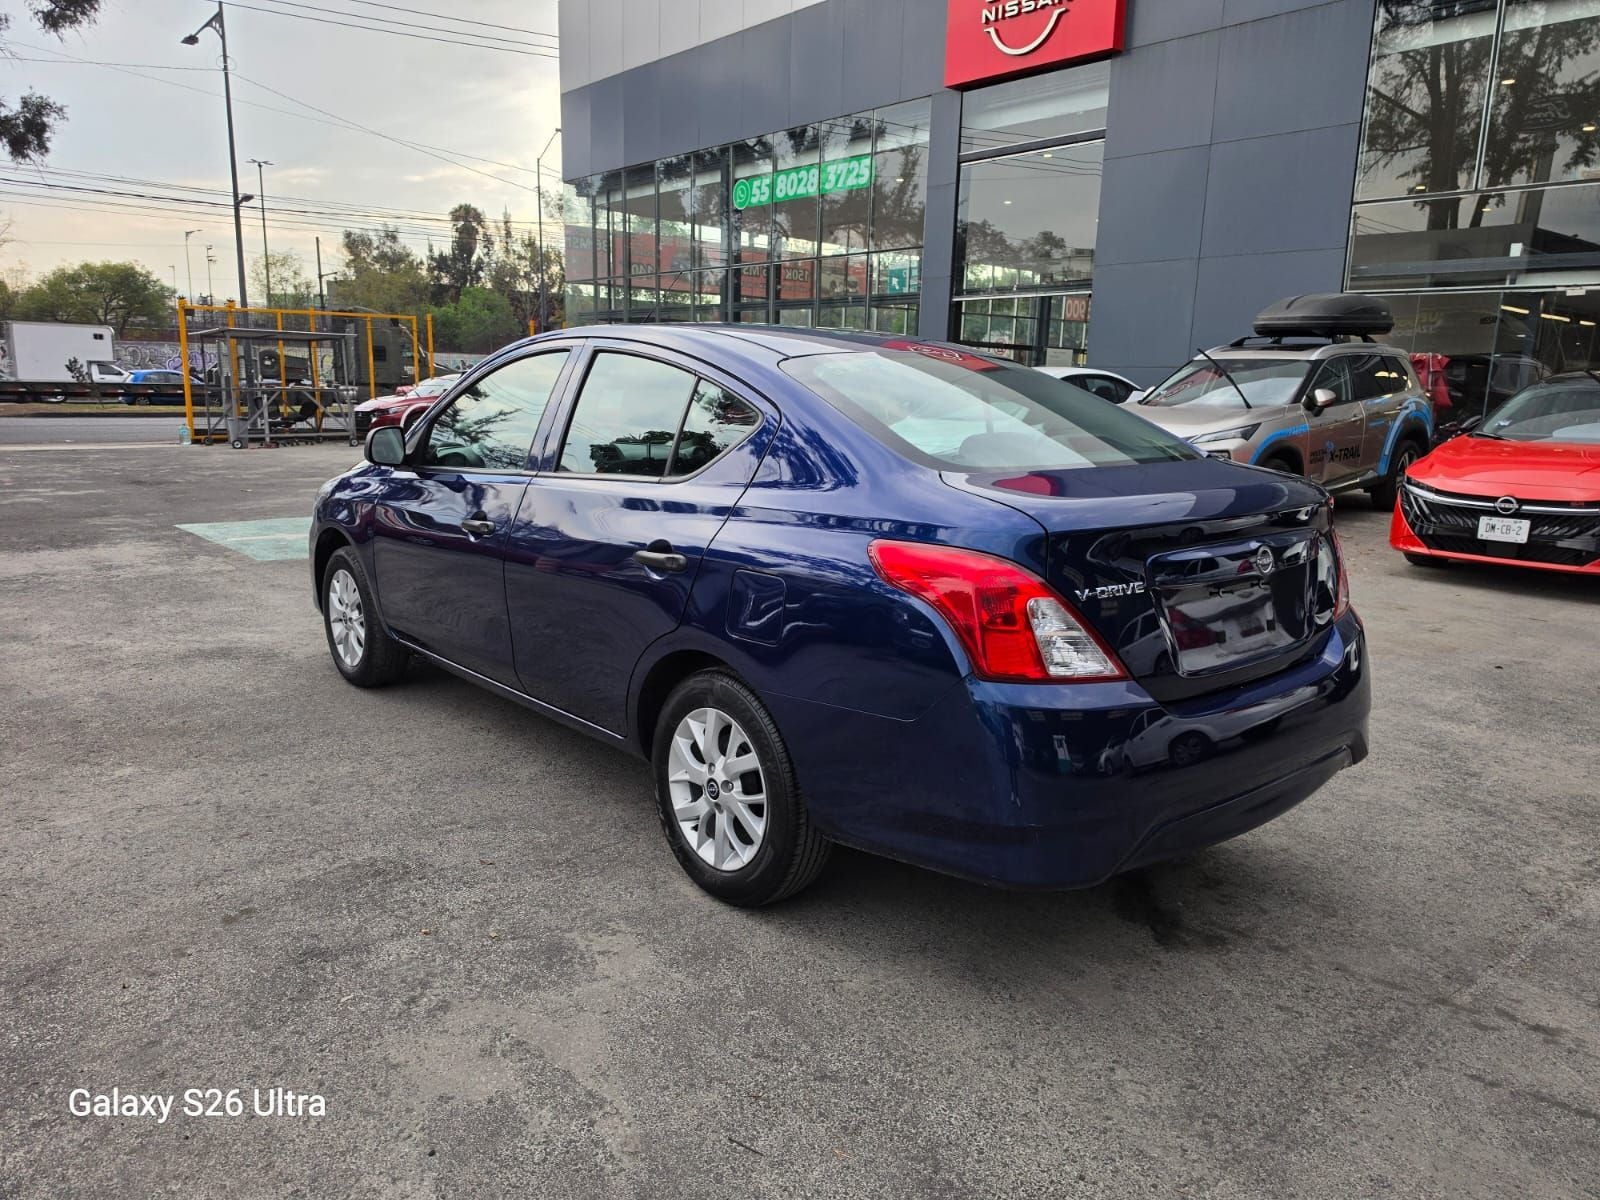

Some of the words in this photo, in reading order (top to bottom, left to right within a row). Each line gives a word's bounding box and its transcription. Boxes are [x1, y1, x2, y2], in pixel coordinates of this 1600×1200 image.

[981, 0, 1060, 24] NISSA
[751, 178, 770, 203] 55
[775, 168, 820, 198] 8028
[824, 158, 872, 190] 3725
[1328, 445, 1361, 463] X-TRAIL
[1485, 522, 1522, 536] DM-CB-2
[1074, 581, 1146, 602] V-DRIVE
